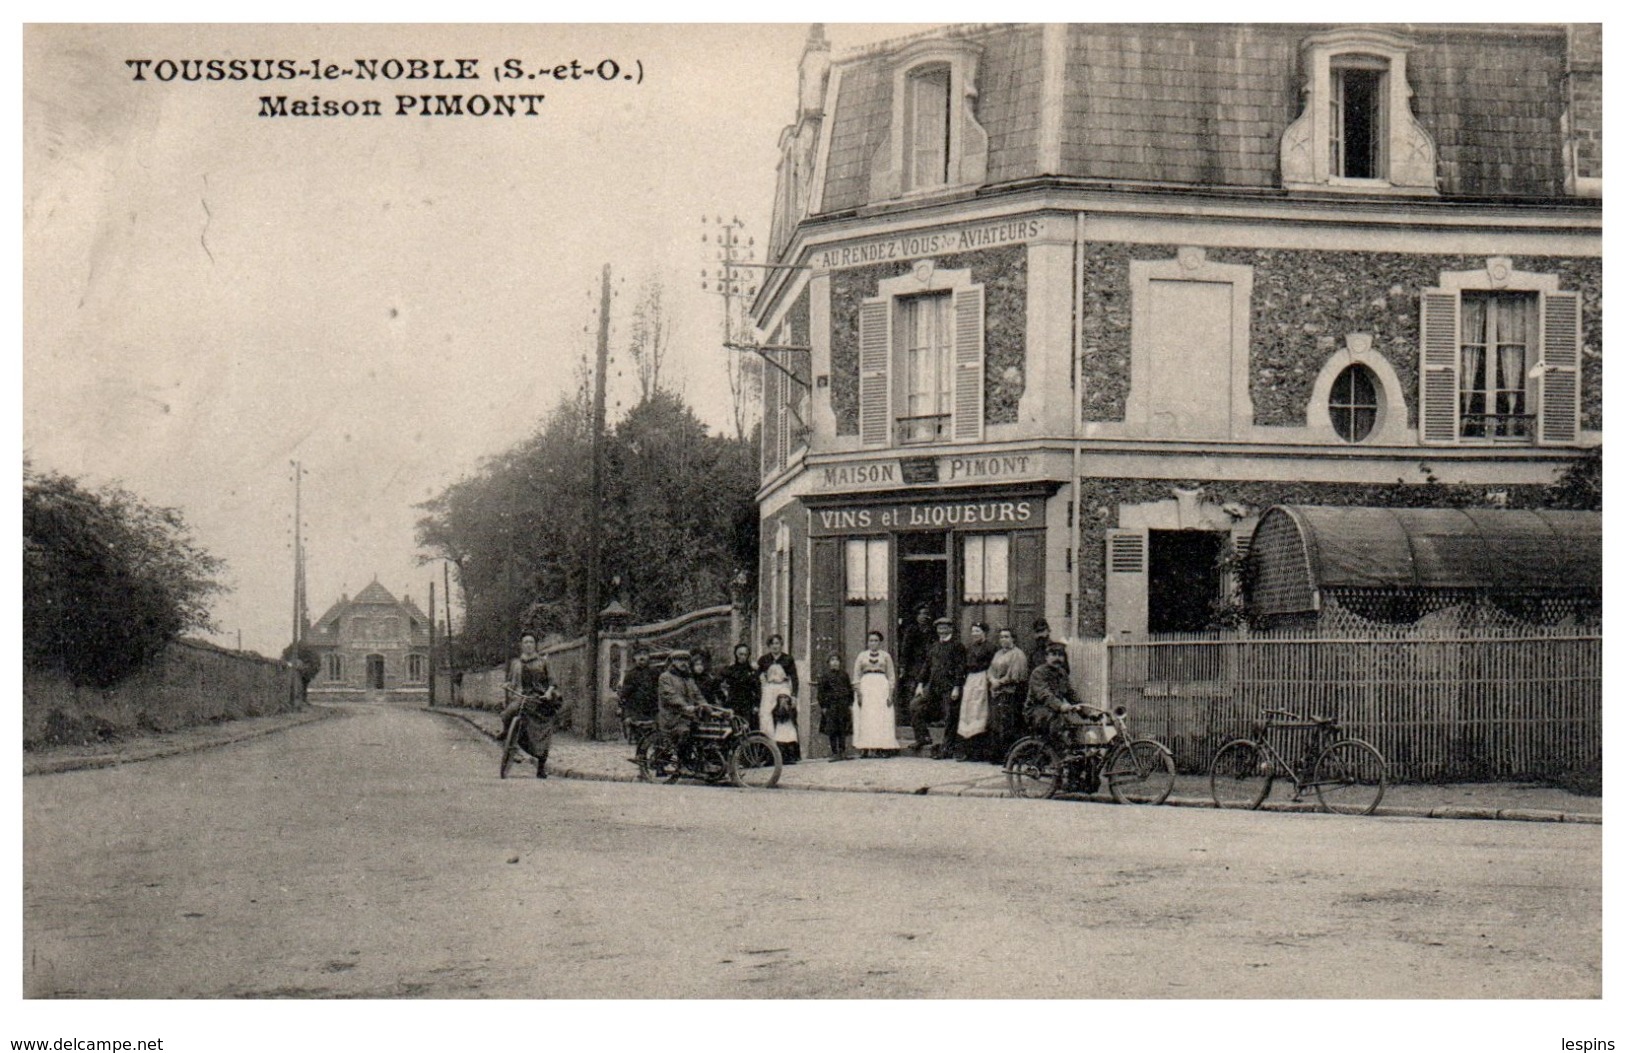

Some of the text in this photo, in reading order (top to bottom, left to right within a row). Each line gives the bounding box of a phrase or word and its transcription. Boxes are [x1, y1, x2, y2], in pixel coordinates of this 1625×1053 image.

[823, 465, 894, 487] MAISON
[950, 456, 1029, 479] PIMONT
[820, 502, 1031, 529] VINS et LIQUEURS
